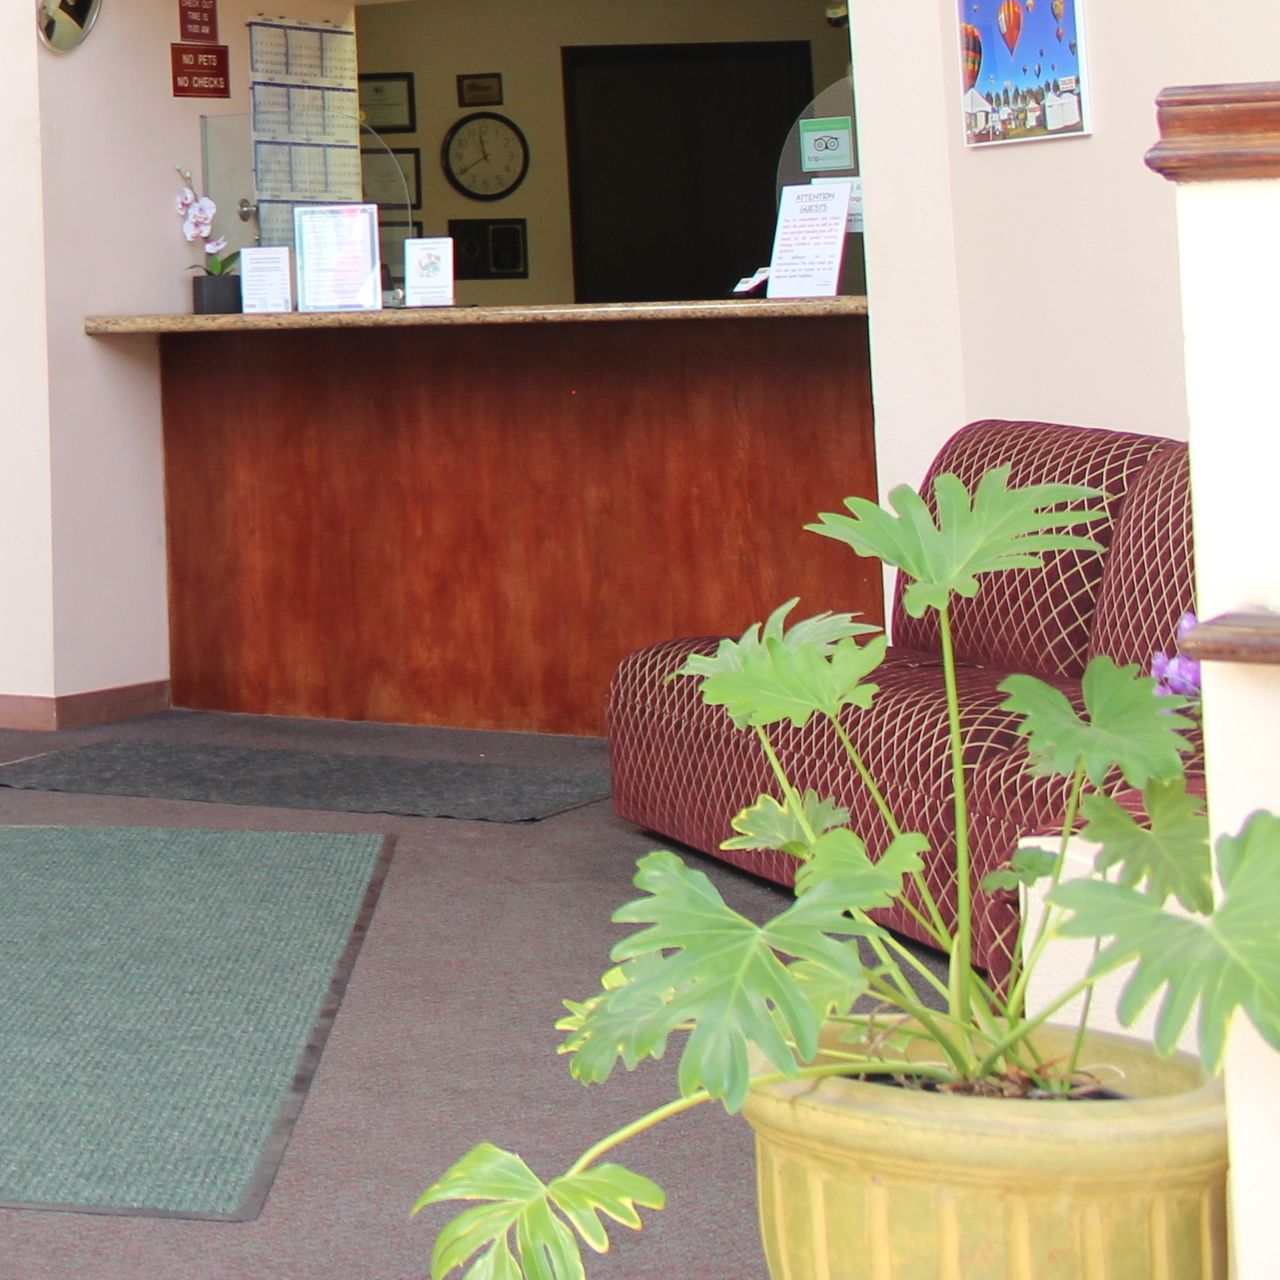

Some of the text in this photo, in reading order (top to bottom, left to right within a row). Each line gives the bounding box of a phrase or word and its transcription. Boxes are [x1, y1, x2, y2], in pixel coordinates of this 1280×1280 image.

[202, 0, 214, 9] OUT
[187, 11, 209, 21] TIME IS
[201, 25, 210, 34] AM
[182, 53, 217, 66] NO PETS
[177, 76, 225, 88] NO CHECKS
[795, 191, 836, 201] ATTENTION
[799, 202, 828, 212] GUESTS
